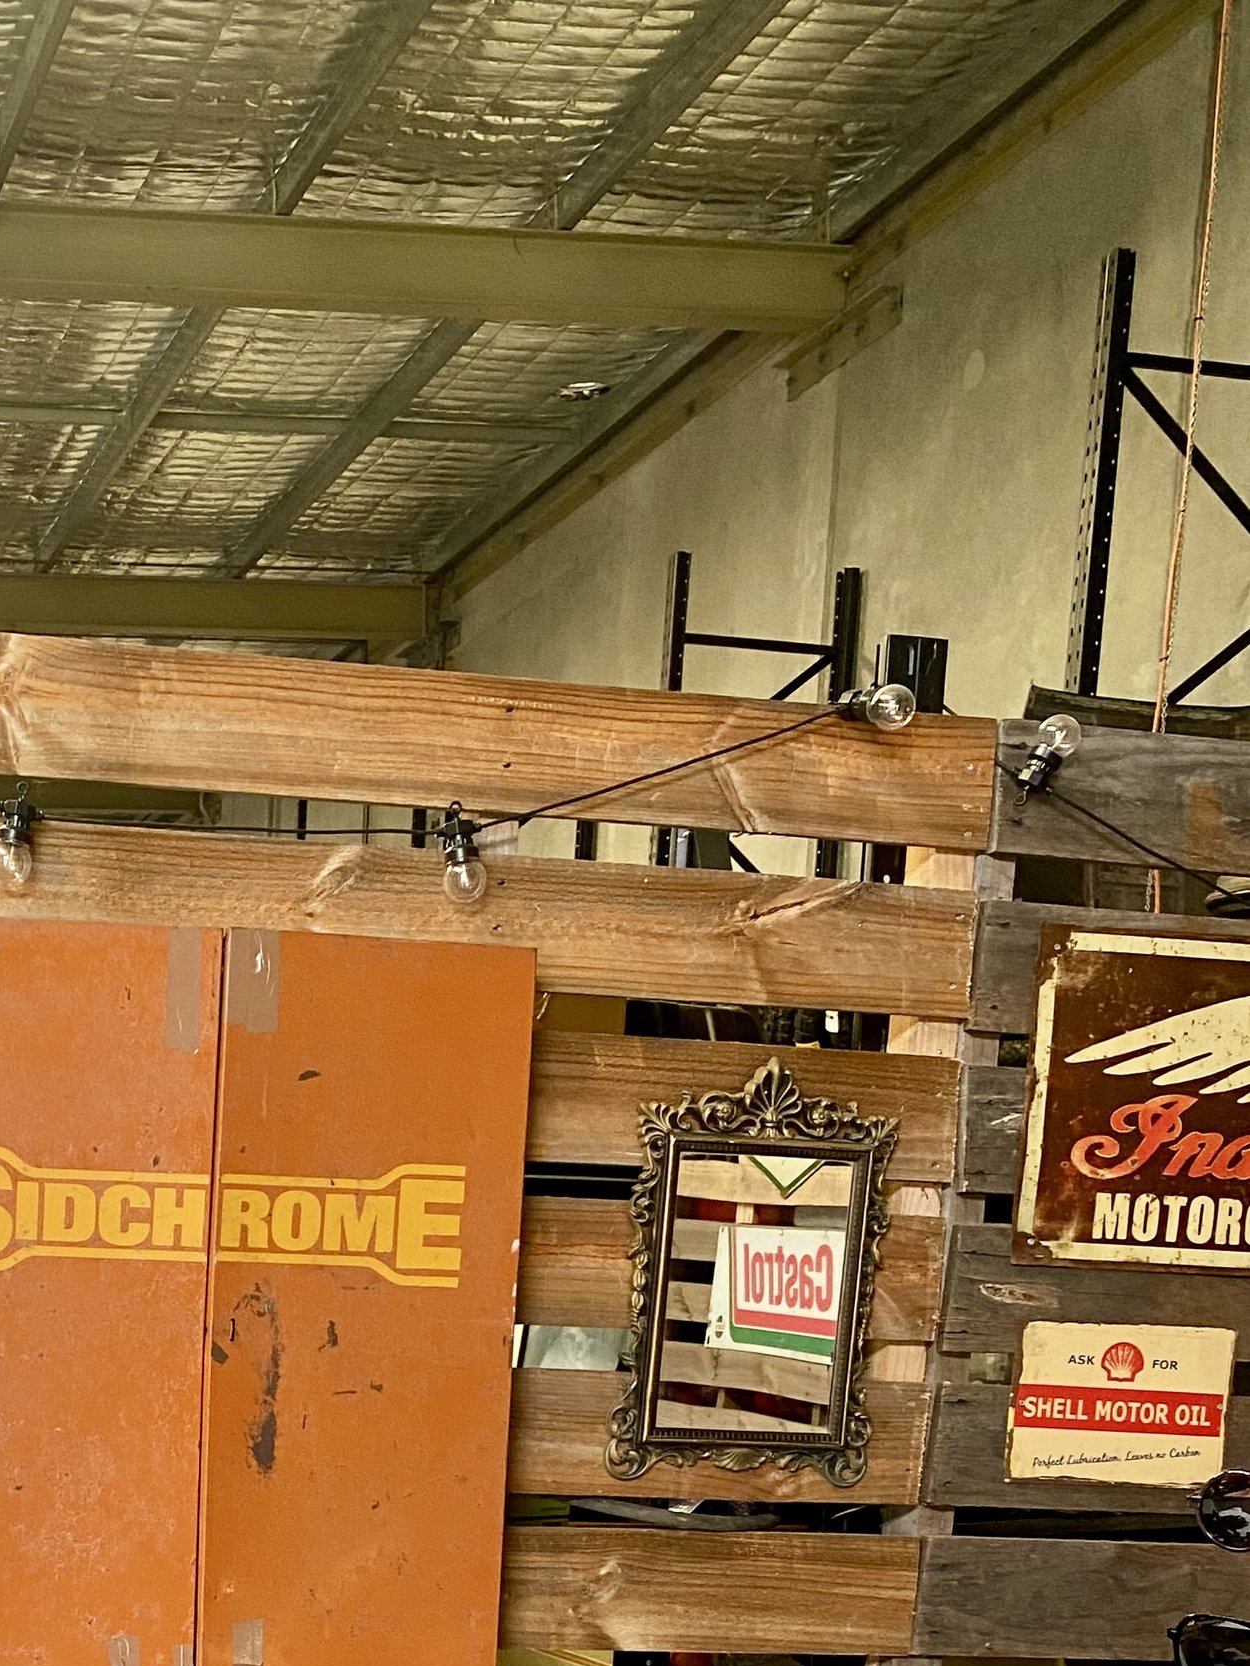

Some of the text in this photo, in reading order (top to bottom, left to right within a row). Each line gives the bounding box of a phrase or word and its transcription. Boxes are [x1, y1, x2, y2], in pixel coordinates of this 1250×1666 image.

[1092, 1191, 1250, 1246] MOTOR
[1068, 1354, 1179, 1371] ASK FOR
[1022, 1395, 1212, 1427] SHELL MOTOR OIL
[1032, 1456, 1066, 1469] Perfect
[1124, 1450, 1154, 1461] Leaves
[1168, 1445, 1202, 1459] Carbon
